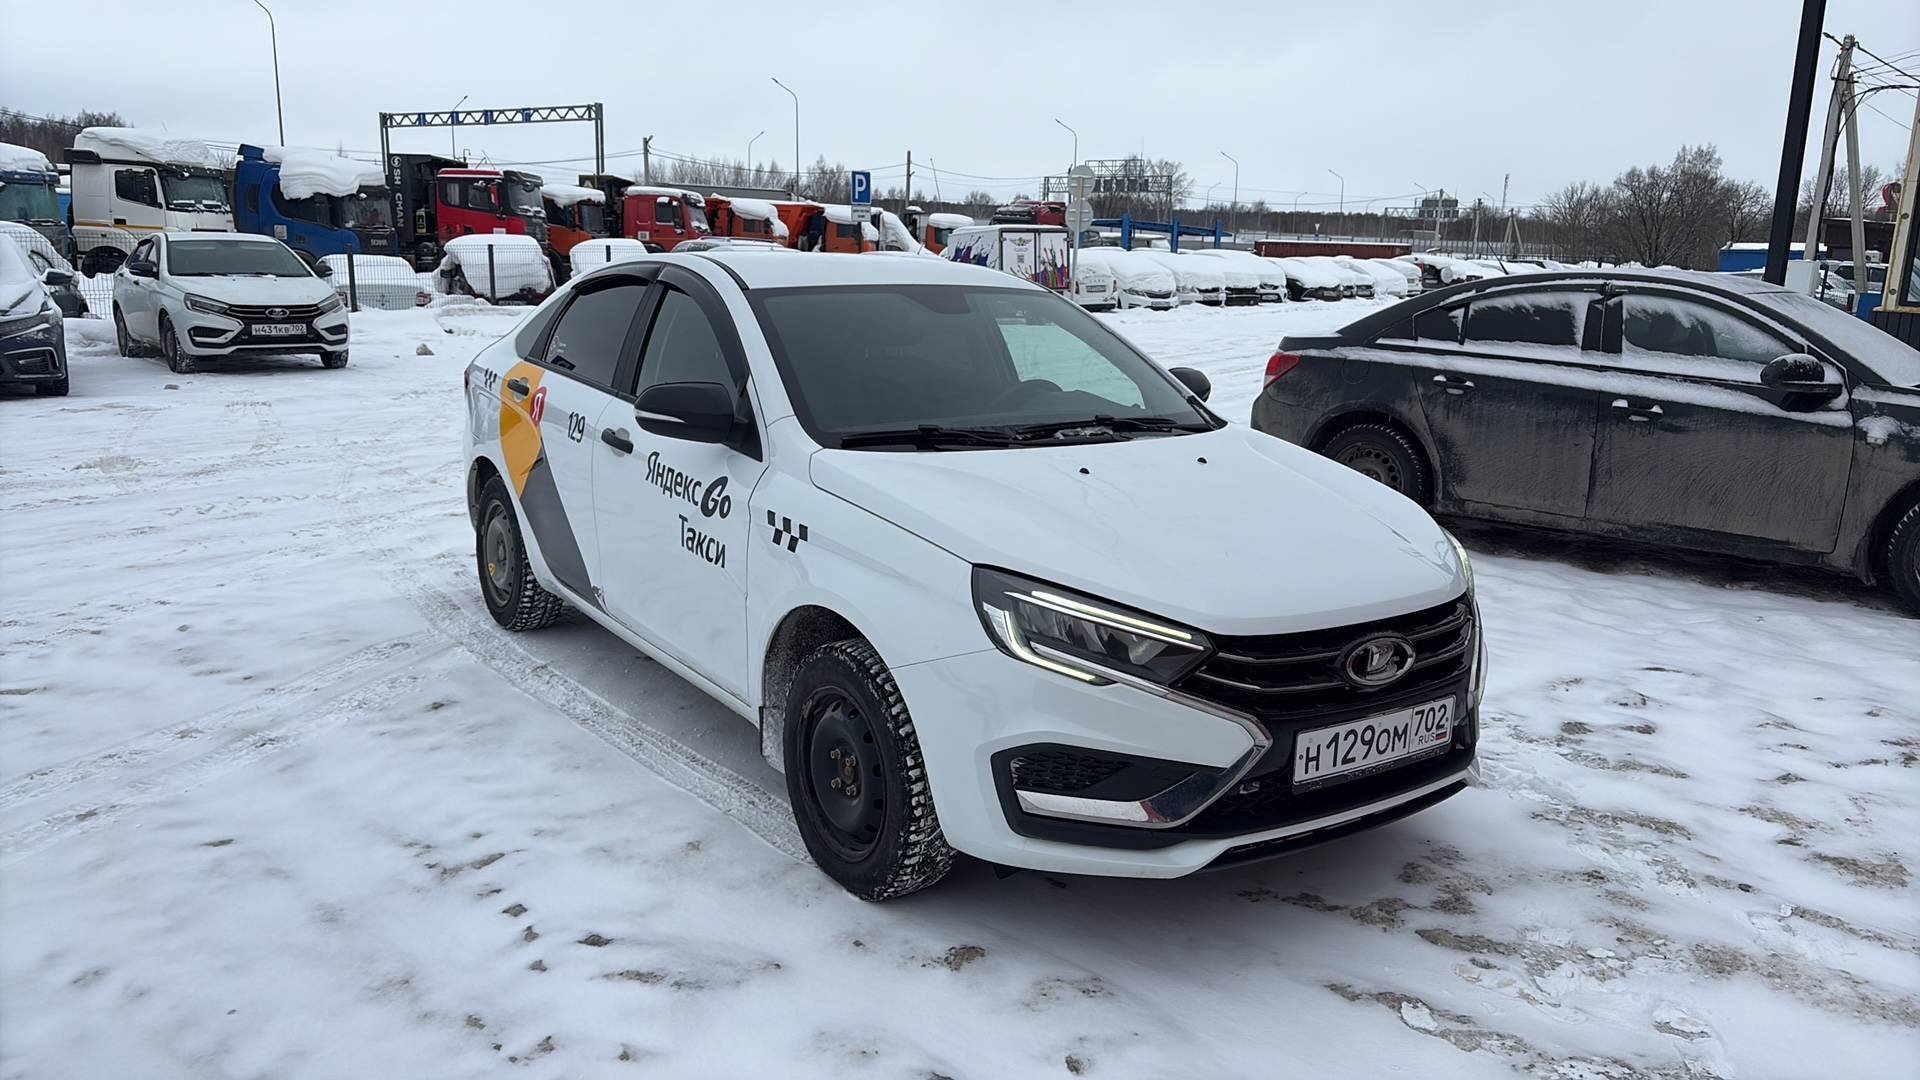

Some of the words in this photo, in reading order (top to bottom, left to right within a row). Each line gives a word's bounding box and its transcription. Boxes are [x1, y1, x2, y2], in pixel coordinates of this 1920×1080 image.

[392, 168, 404, 228] SHCMAN
[855, 174, 867, 200] P
[531, 393, 544, 421] Я
[567, 411, 586, 443] 129
[645, 451, 703, 507] Яндекс
[700, 476, 732, 519] Go
[678, 513, 726, 569] Такси
[1414, 703, 1448, 737] 702
[1418, 733, 1436, 746] RUS
